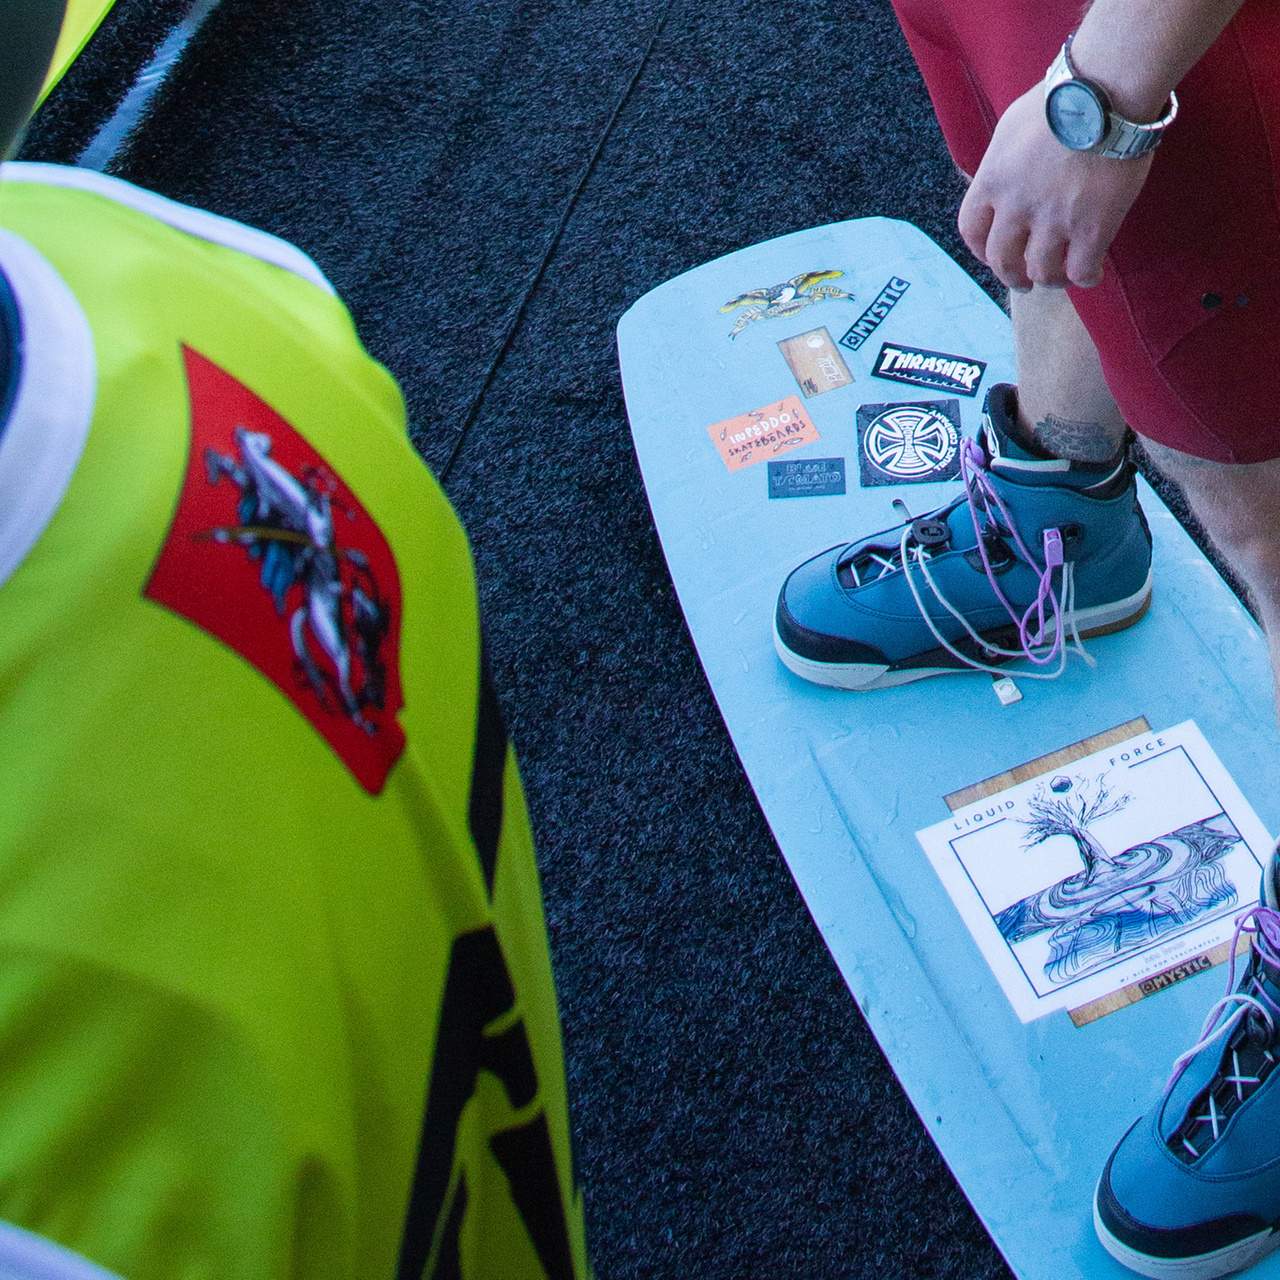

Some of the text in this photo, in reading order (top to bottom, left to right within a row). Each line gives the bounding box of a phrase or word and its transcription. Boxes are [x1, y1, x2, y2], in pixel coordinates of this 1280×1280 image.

[854, 277, 908, 338] MYSTIC
[879, 347, 981, 390] THRASHER
[953, 737, 1167, 831] LIQUID FORCE
[1154, 955, 1212, 988] MYSTIC
